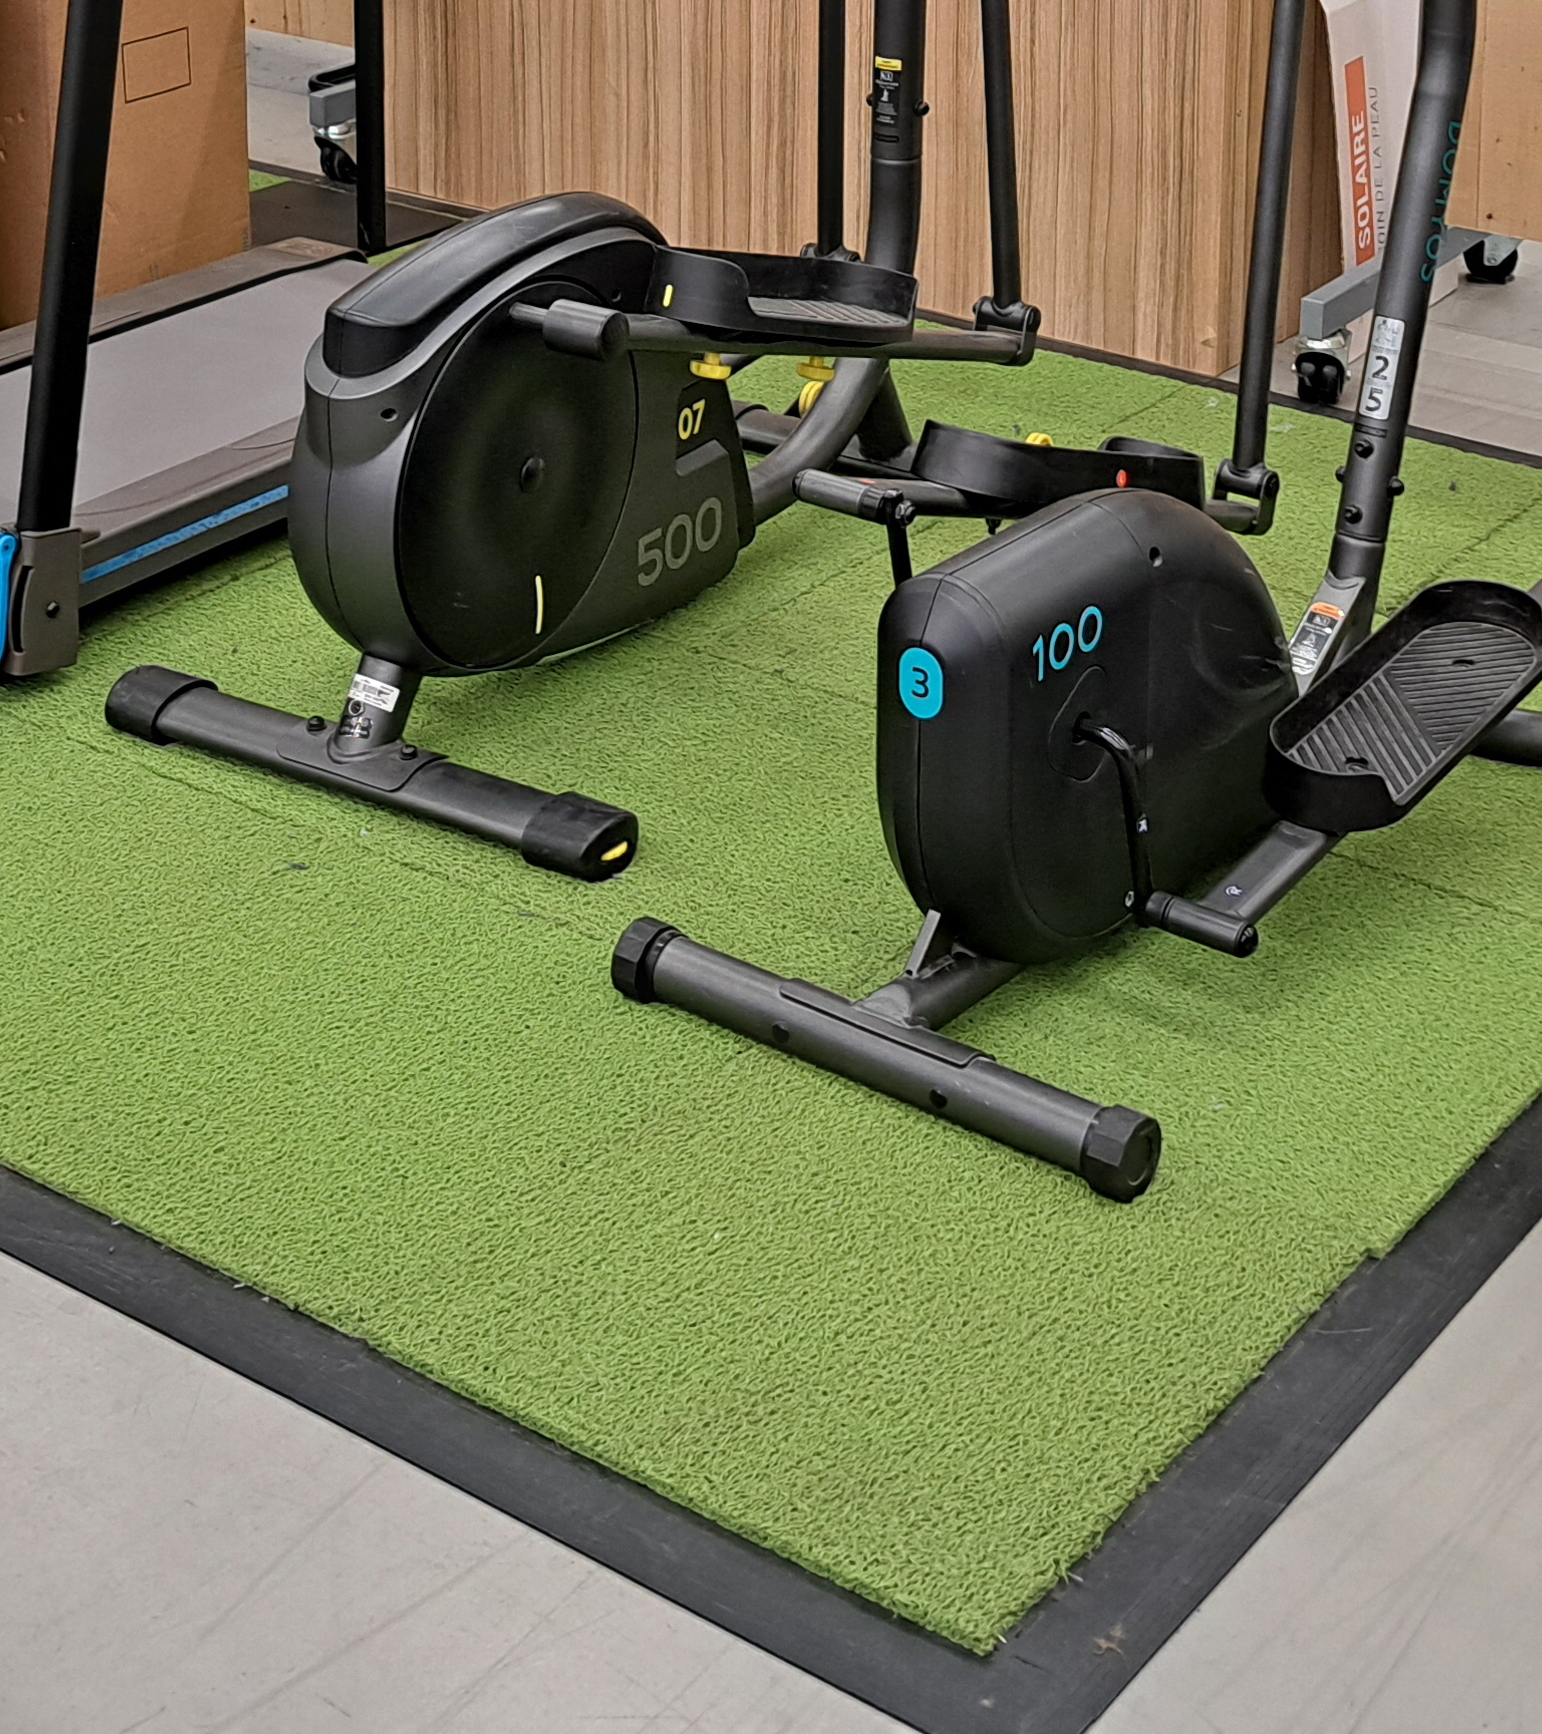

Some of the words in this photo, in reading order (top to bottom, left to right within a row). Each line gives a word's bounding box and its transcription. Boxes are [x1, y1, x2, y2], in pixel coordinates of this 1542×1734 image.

[1368, 86, 1380, 138] PEAU
[1371, 146, 1382, 170] LA
[1352, 109, 1372, 251] SOLAIRE
[1373, 178, 1384, 204] DE
[1421, 119, 1462, 284] DOMYOS
[1371, 355, 1389, 381] 2
[677, 399, 706, 440] 07
[1364, 387, 1384, 413] 5
[637, 496, 723, 587] 500
[1032, 605, 1103, 682] 100
[910, 667, 930, 698] 3
